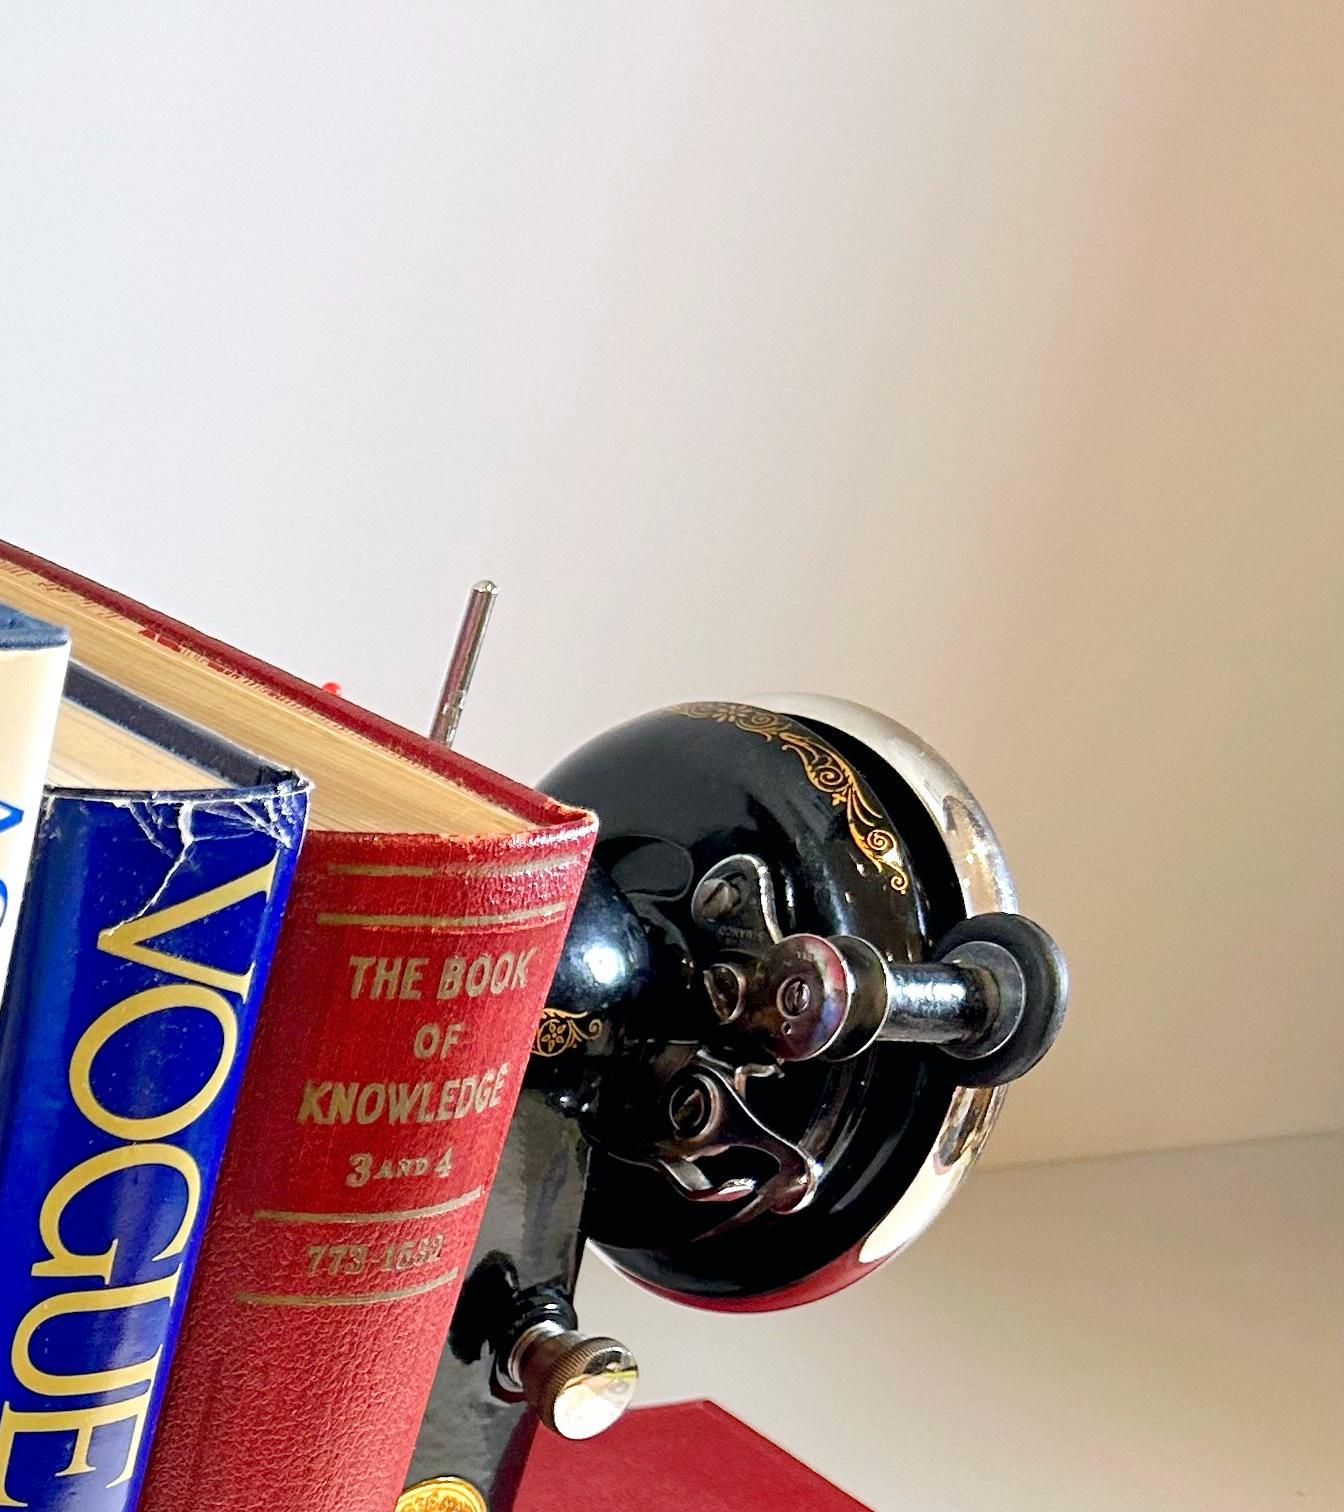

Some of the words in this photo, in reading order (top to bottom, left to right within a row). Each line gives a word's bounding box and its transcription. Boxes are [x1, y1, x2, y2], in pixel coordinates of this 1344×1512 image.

[350, 956, 429, 999] THE
[437, 947, 540, 998] BOOK
[414, 1023, 464, 1060] OF
[296, 1063, 509, 1125] KNOWLEDGE
[346, 1152, 373, 1187] 3
[373, 1157, 430, 1180] AND
[434, 1147, 454, 1177] 4
